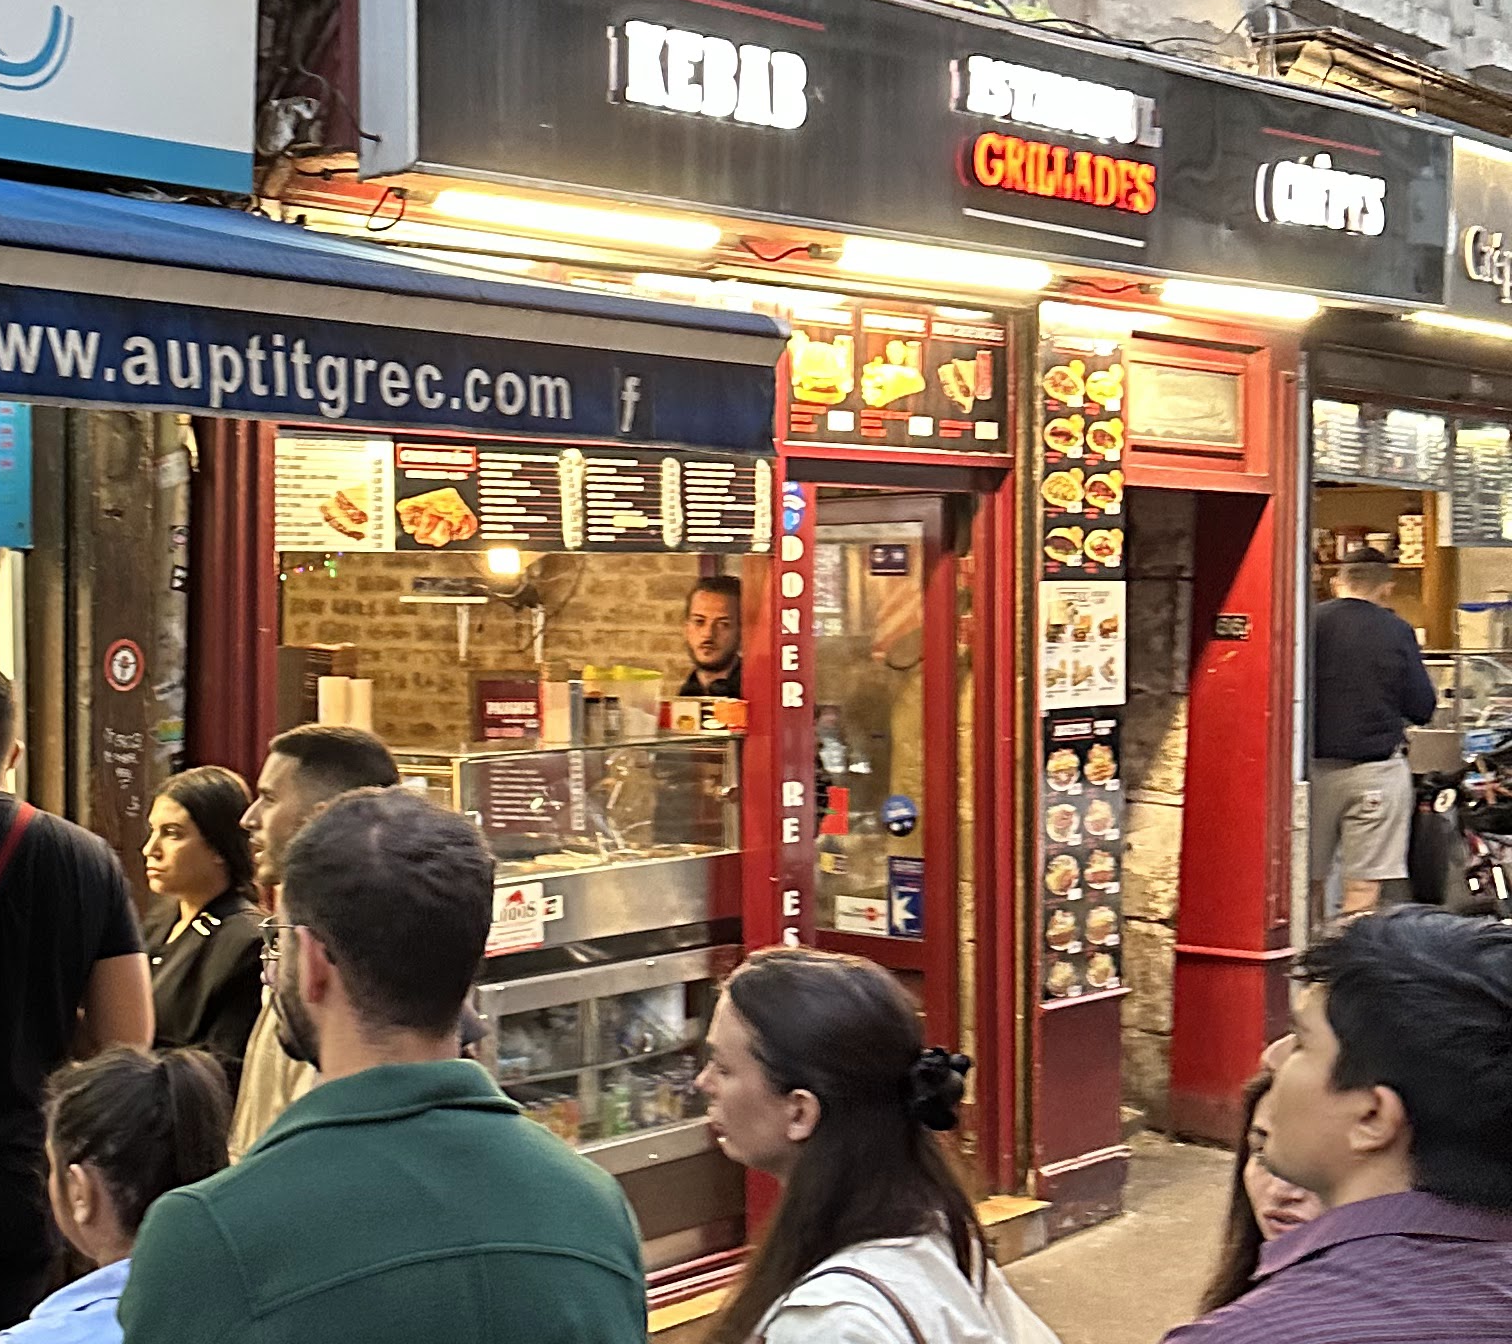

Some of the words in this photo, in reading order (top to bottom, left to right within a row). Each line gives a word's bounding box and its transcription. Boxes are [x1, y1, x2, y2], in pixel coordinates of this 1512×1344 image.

[965, 54, 1164, 149] ISTUL
[972, 131, 1157, 216] GRILLADES
[781, 534, 805, 709] DONER
